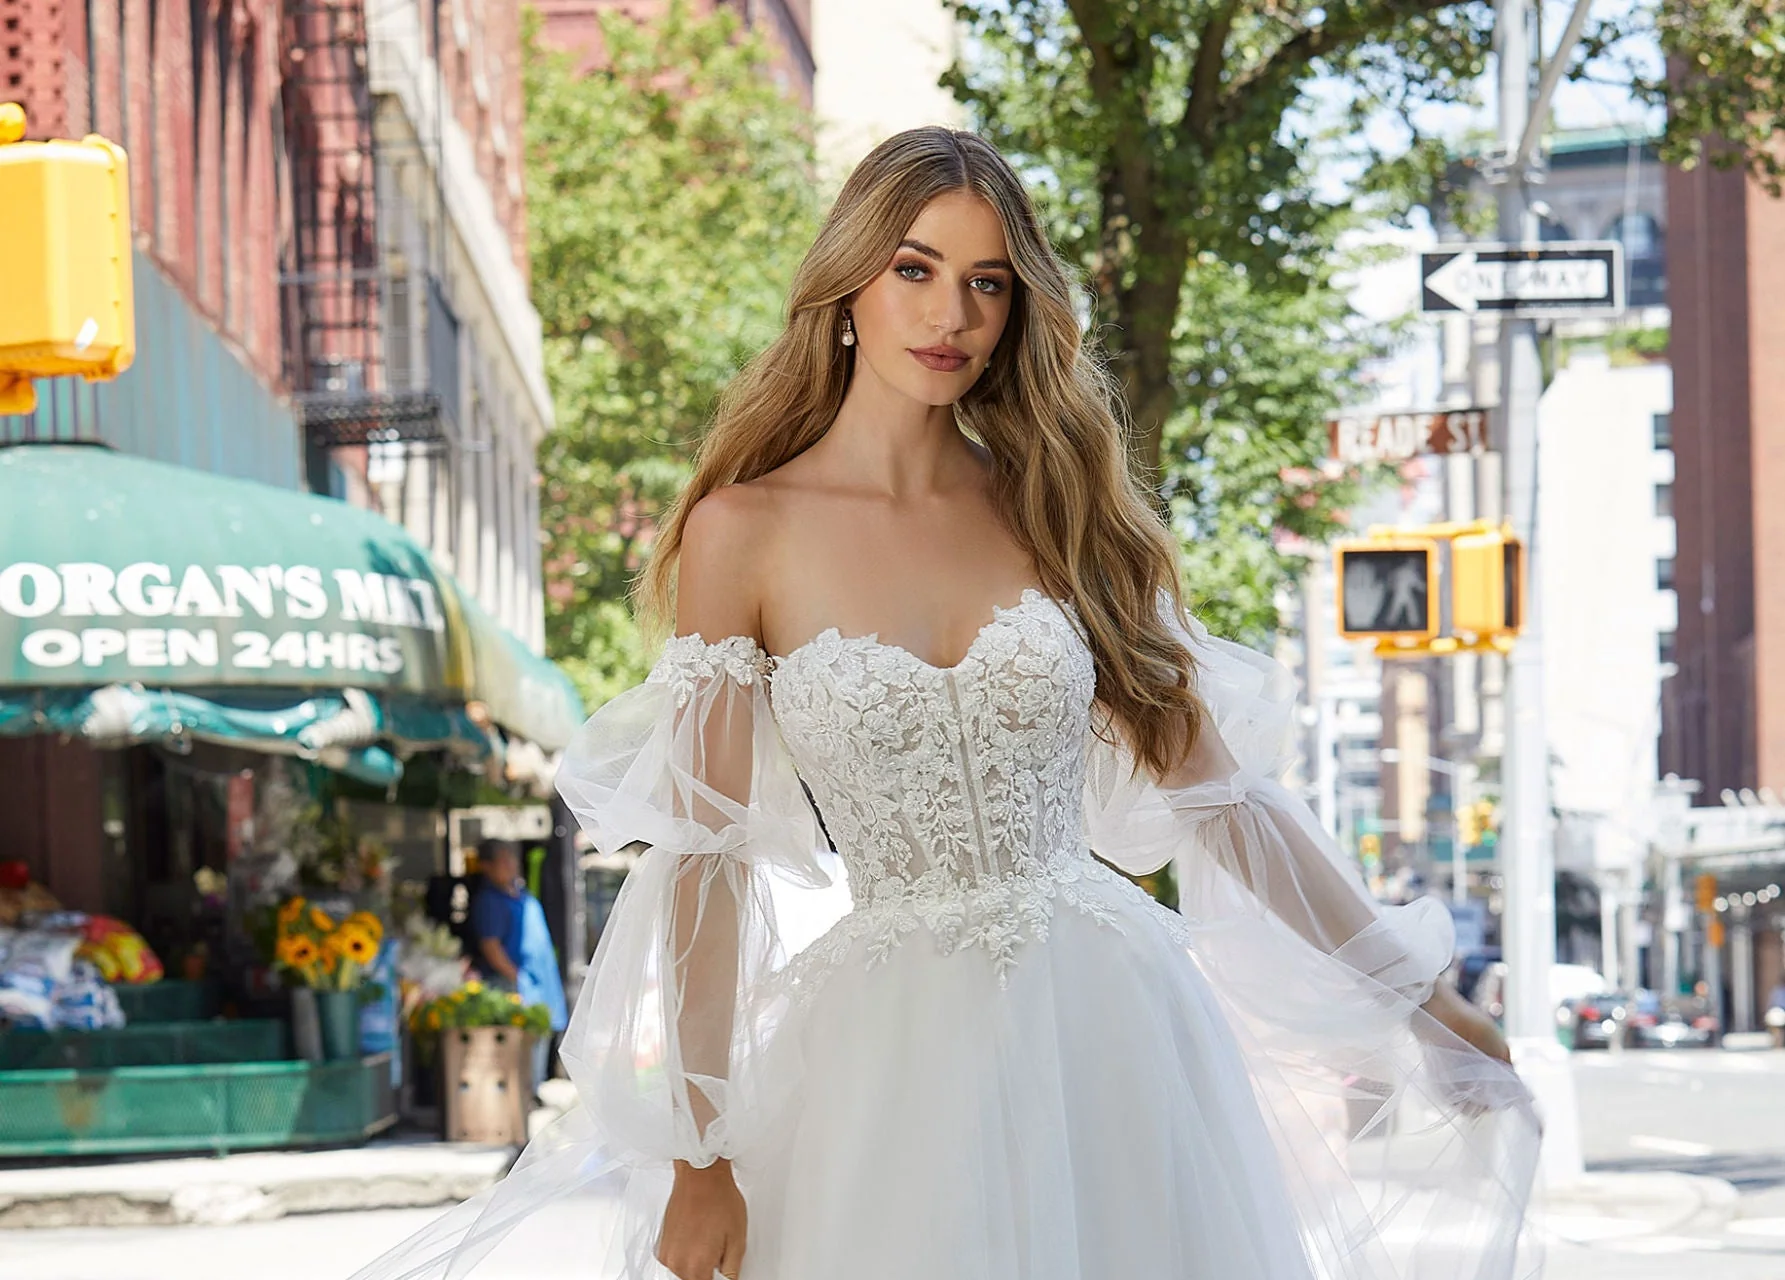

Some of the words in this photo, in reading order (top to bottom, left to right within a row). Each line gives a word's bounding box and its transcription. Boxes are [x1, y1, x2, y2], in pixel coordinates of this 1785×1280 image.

[1520, 266, 1591, 291] WAY
[21, 628, 219, 667] OPEN
[231, 631, 404, 674] 24HRS
